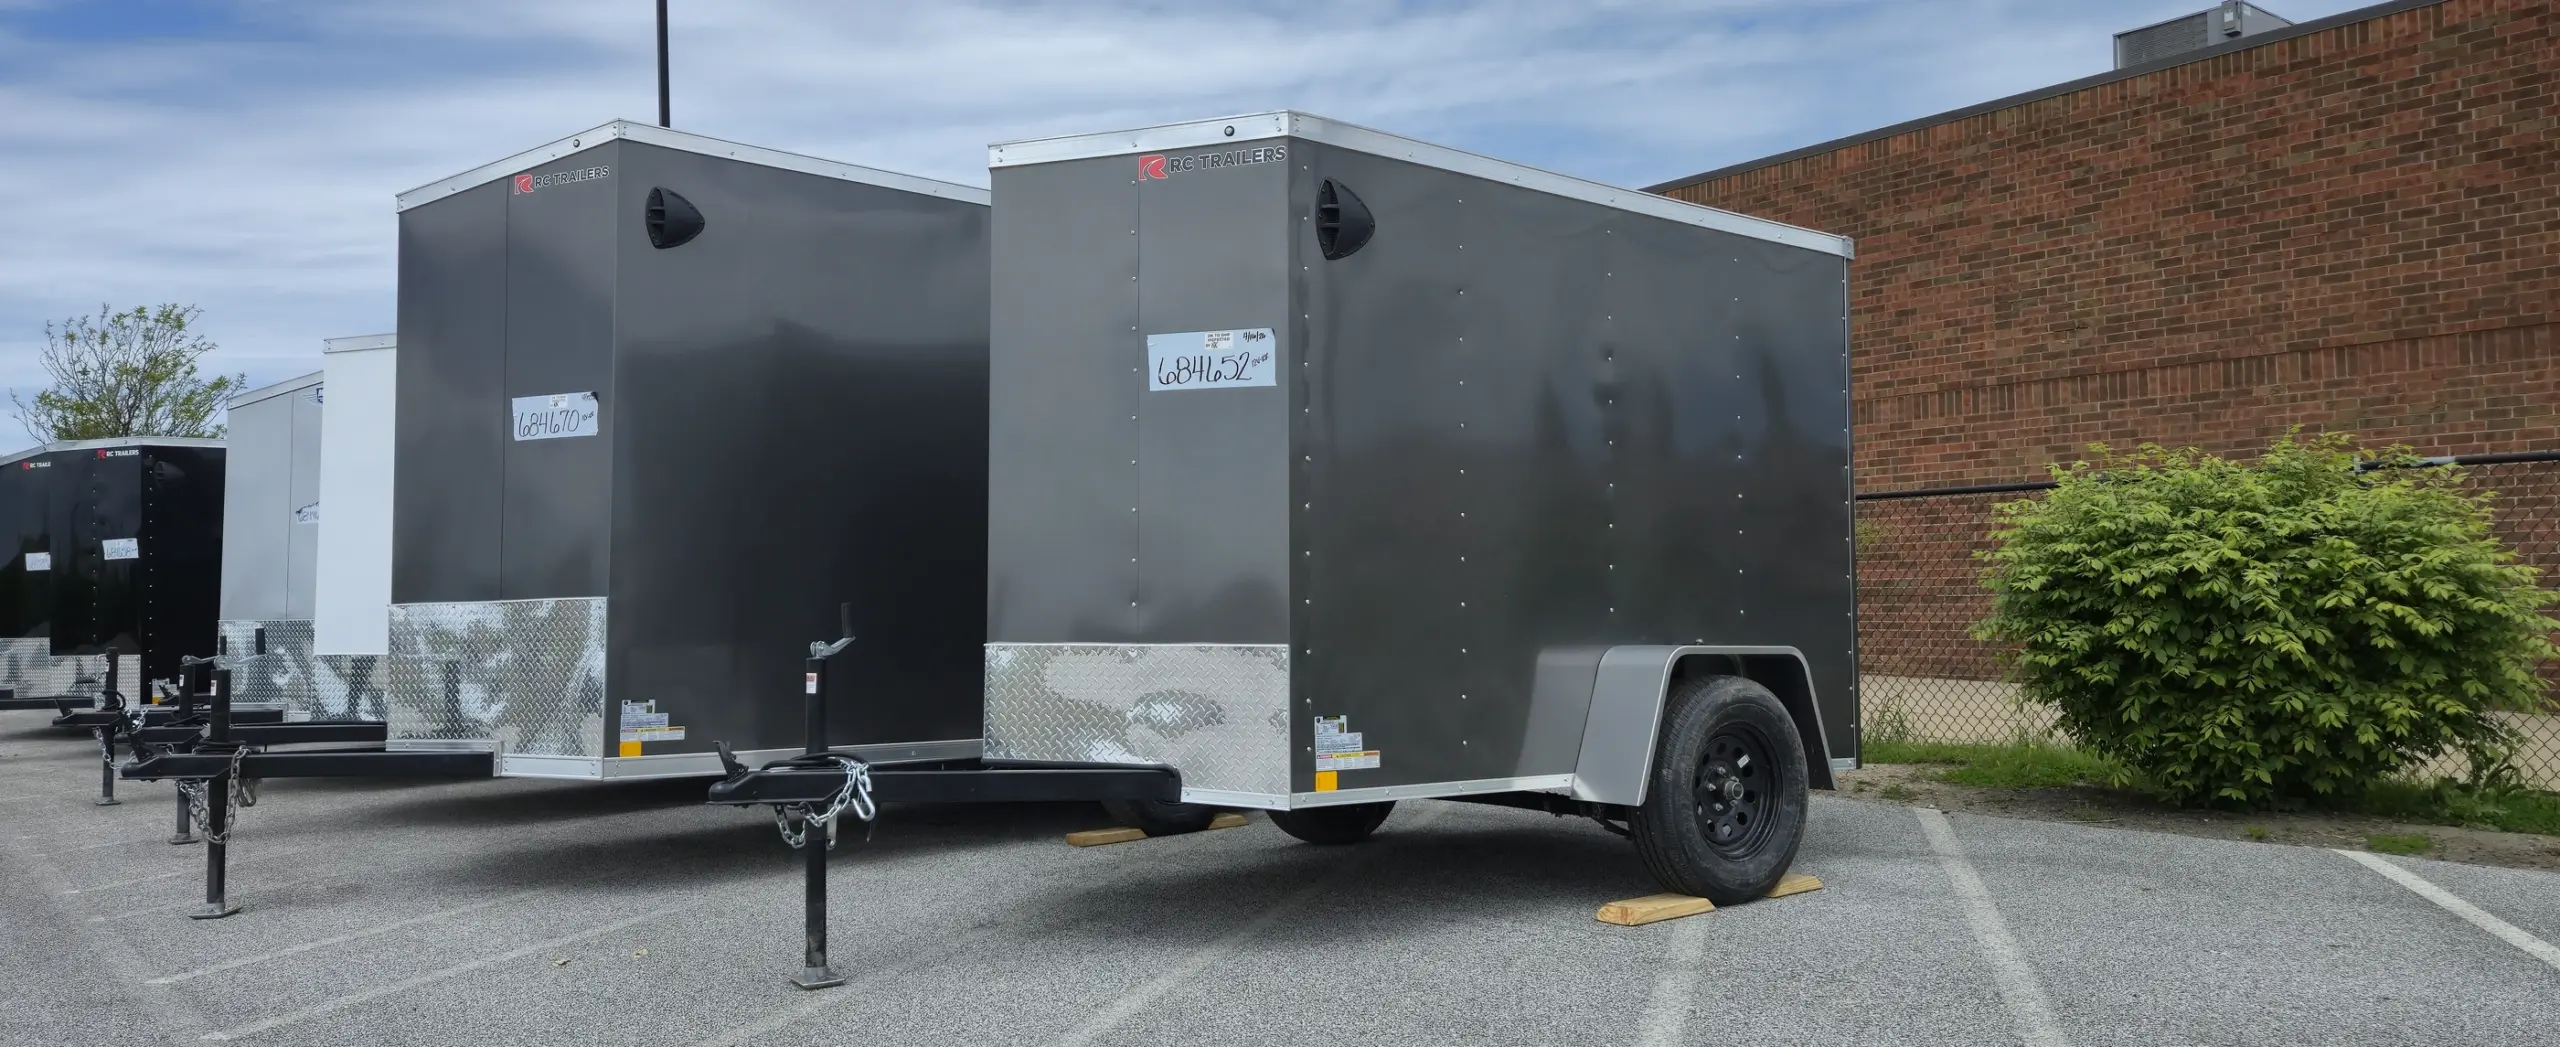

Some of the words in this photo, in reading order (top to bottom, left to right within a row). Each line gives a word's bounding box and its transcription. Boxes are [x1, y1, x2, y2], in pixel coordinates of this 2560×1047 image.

[1169, 156, 1195, 173] RC
[1199, 145, 1287, 169] TRAILERS
[535, 174, 551, 188] RC
[553, 165, 610, 185] TRAILERS
[1158, 351, 1252, 386] 684652
[518, 409, 580, 437] 684670
